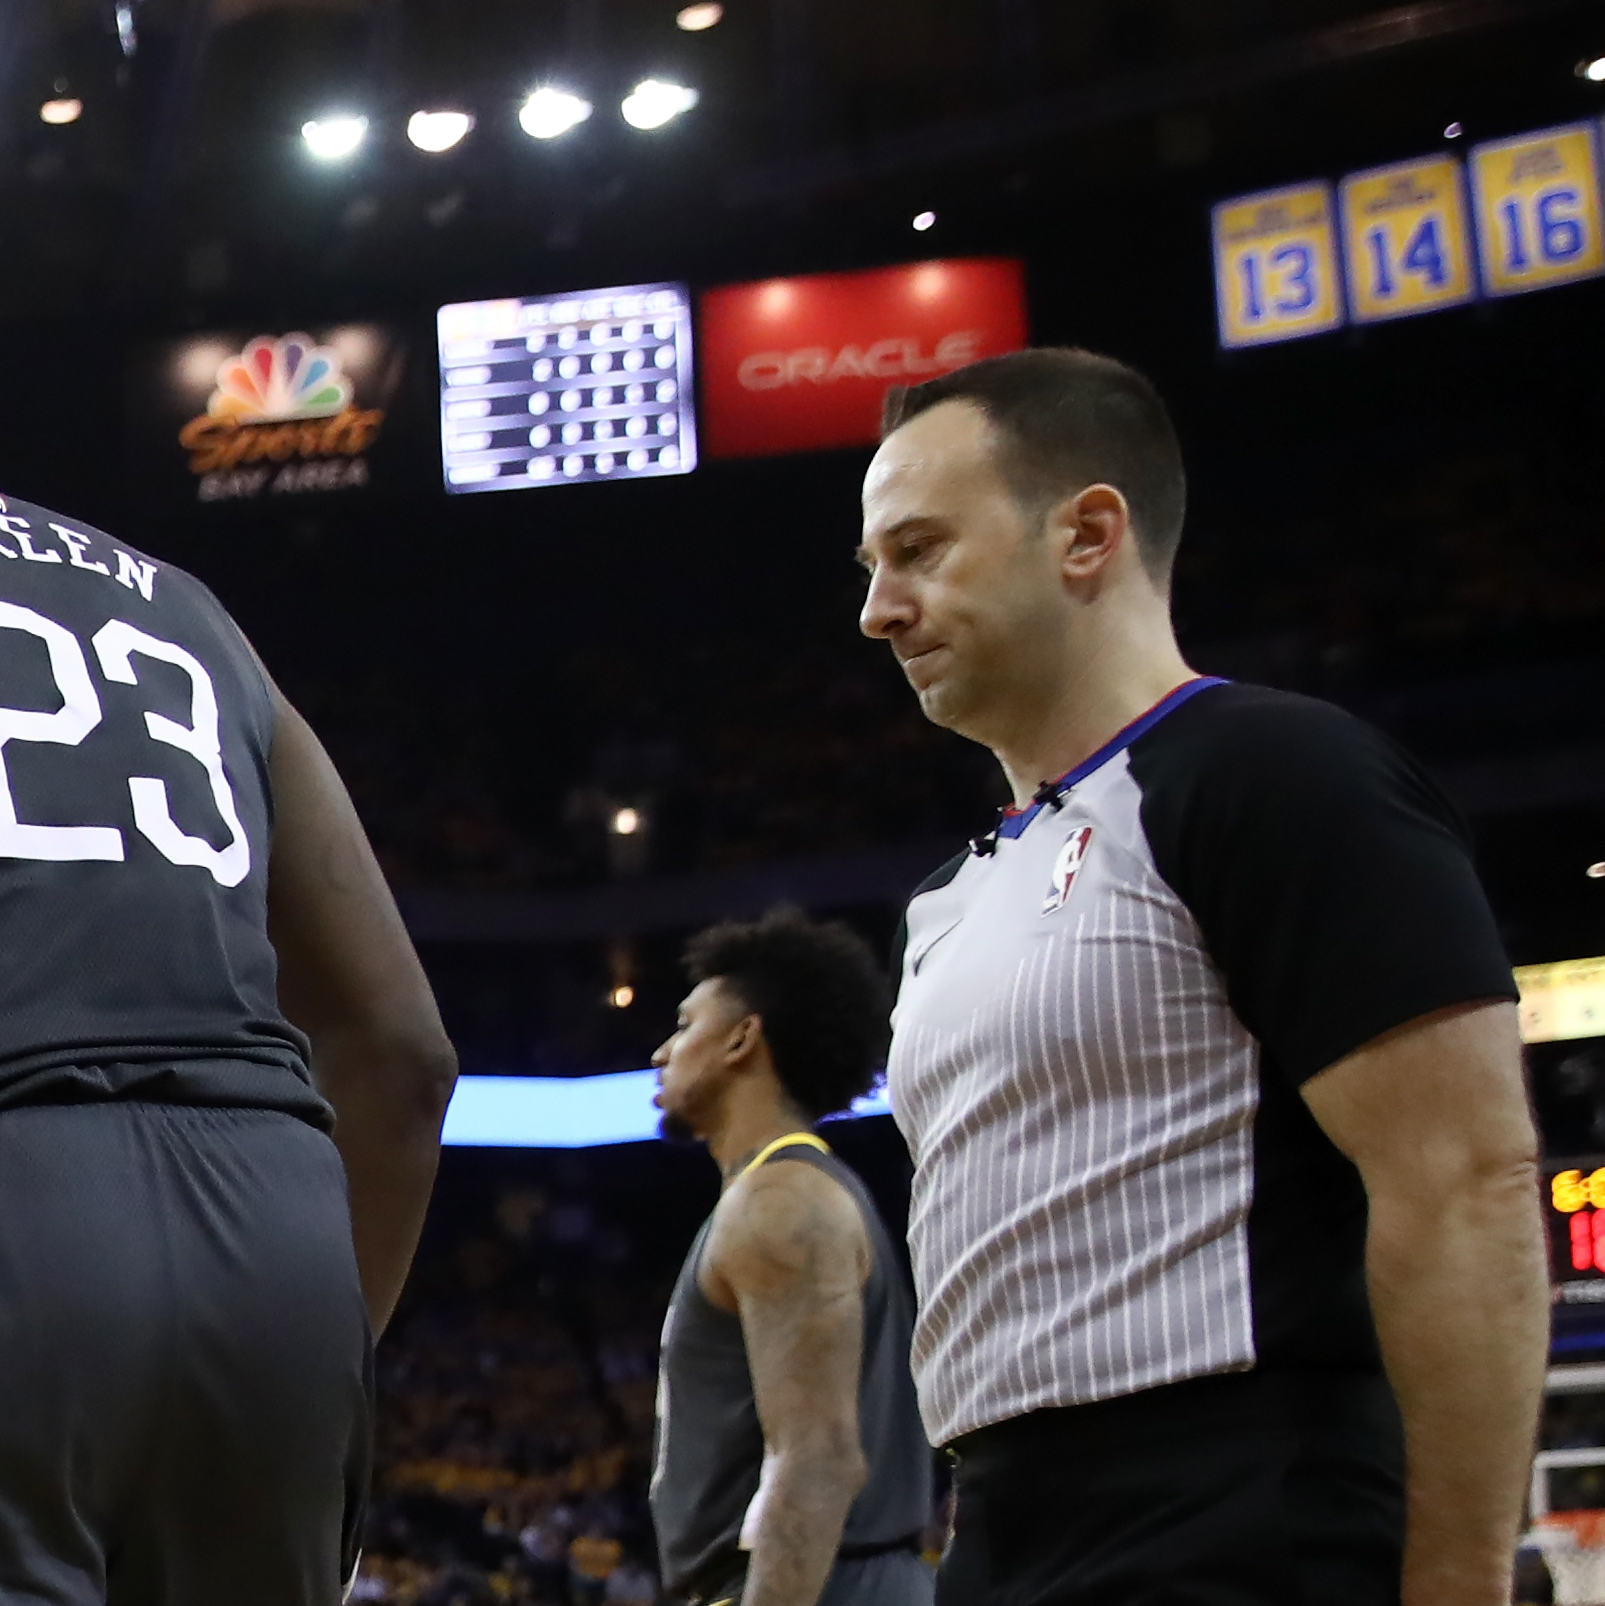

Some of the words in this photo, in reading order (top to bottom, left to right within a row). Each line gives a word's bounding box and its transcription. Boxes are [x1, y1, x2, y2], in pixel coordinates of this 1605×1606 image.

[1367, 215, 1447, 297] 14
[1500, 190, 1585, 269] 16
[1241, 243, 1317, 322] 13
[738, 331, 983, 391] ORACLE
